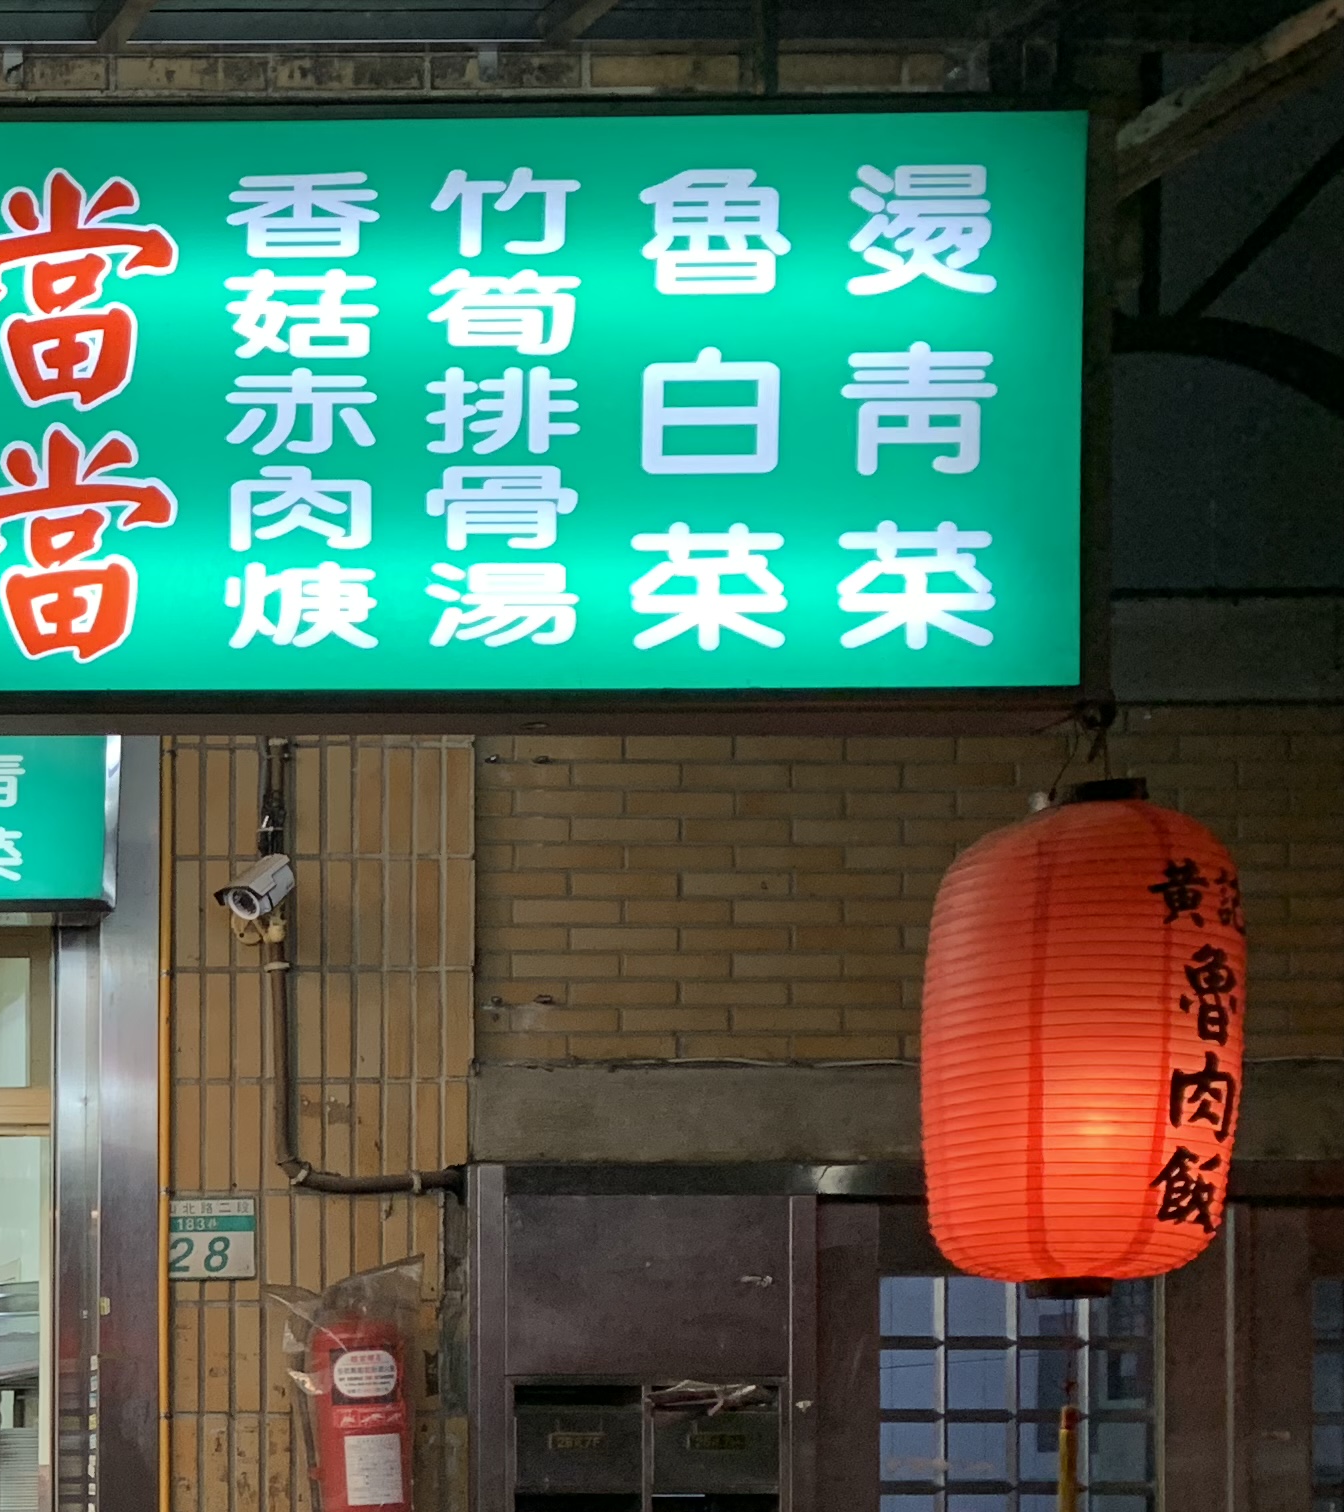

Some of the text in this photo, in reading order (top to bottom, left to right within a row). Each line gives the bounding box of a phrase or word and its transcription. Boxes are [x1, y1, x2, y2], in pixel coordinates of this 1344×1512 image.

[425, 167, 582, 647] 竹筍排骨湯
[629, 168, 791, 652] 魯白菜
[837, 164, 998, 652] 燙青菜
[170, 1236, 230, 1272] 28
[1151, 944, 1237, 1233] 魯肉飯
